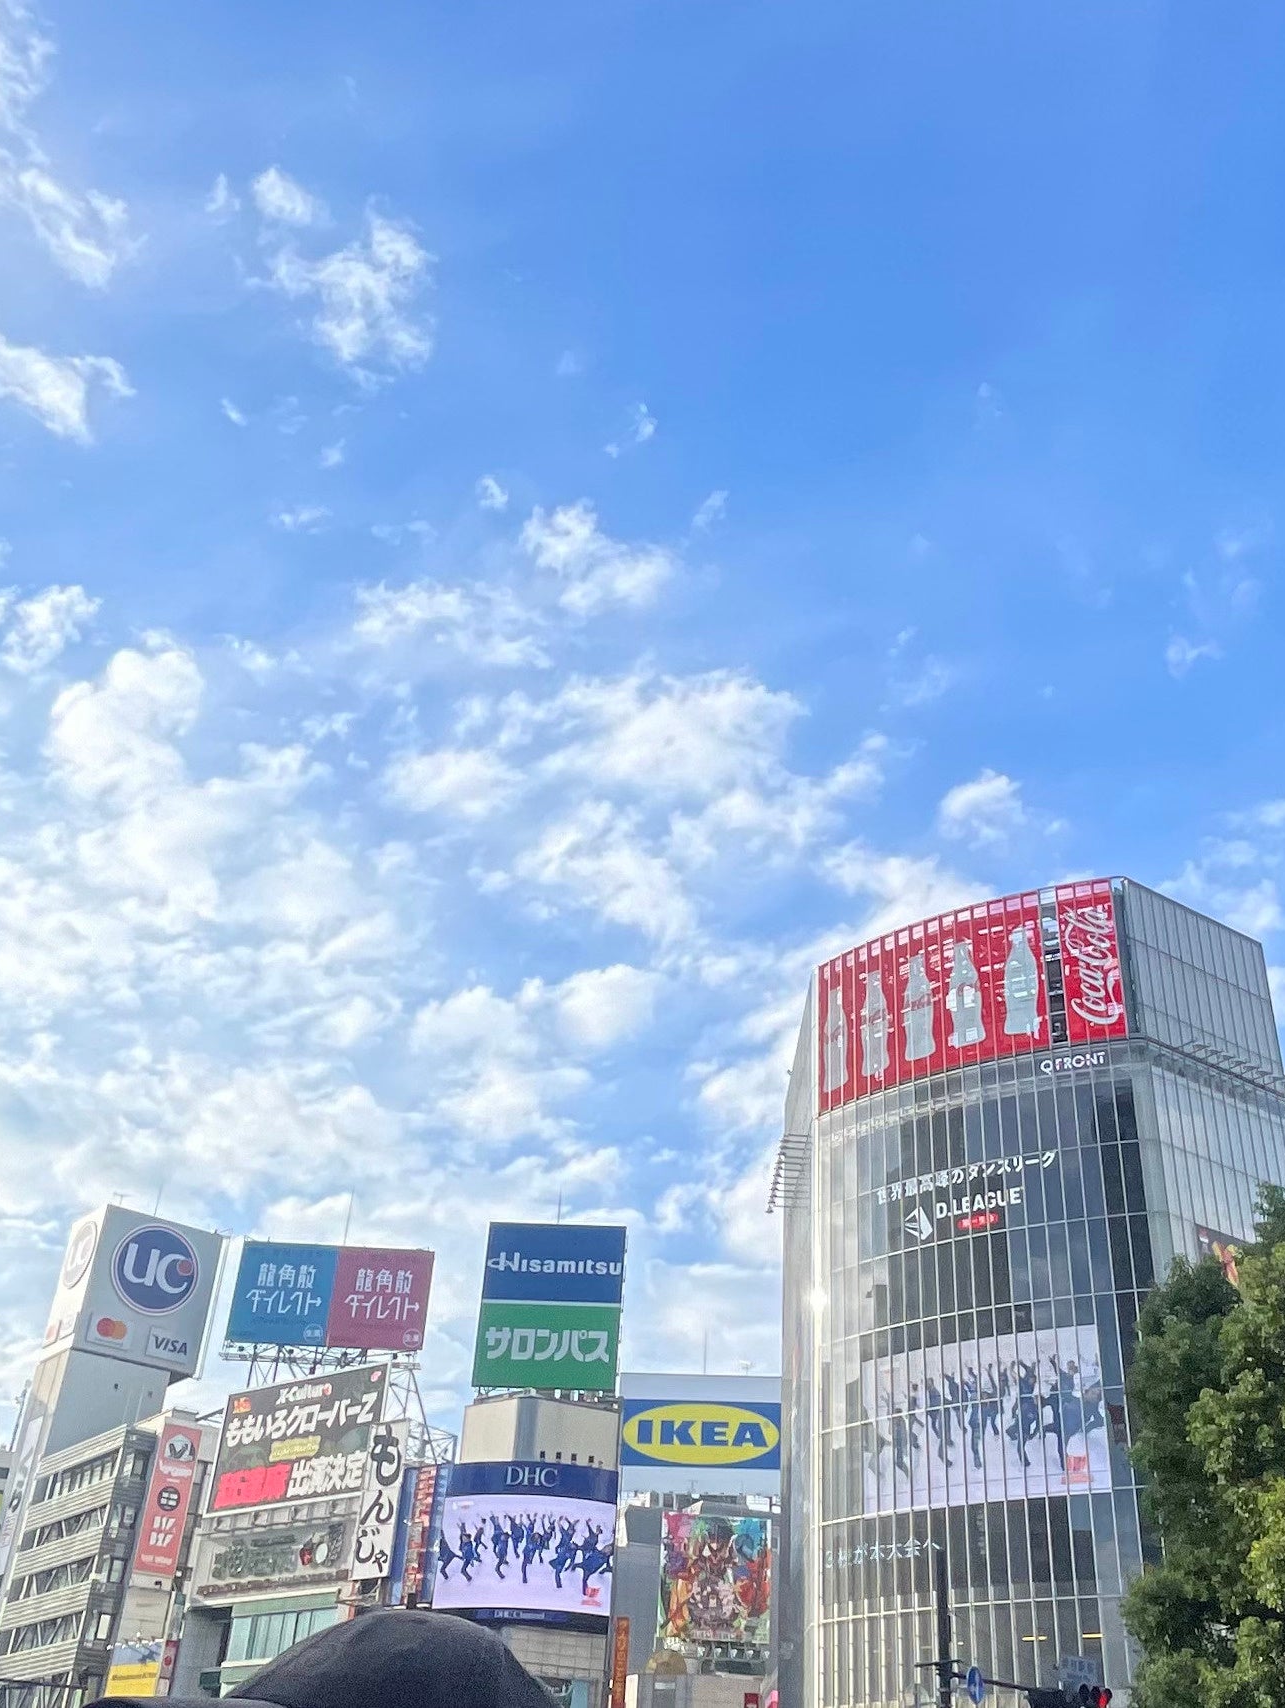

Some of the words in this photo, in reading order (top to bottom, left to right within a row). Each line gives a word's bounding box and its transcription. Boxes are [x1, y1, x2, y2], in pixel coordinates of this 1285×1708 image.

[1040, 1052, 1106, 1075] QFRONT
[936, 1186, 1023, 1219] D.LEAGUE
[257, 1262, 317, 1289] 龍角散
[487, 1251, 622, 1276] Hisamitsu
[355, 1267, 414, 1294] 龍角散
[245, 1288, 322, 1316] ダイレクト
[344, 1294, 420, 1321] ダイレクト
[152, 1333, 188, 1357] VISA
[485, 1326, 609, 1364] サロンパス
[226, 1392, 378, 1448] ももいろクローバーZ
[636, 1418, 769, 1448] IKEA
[505, 1466, 558, 1488] DHC
[355, 1424, 403, 1574] もんじゃ
